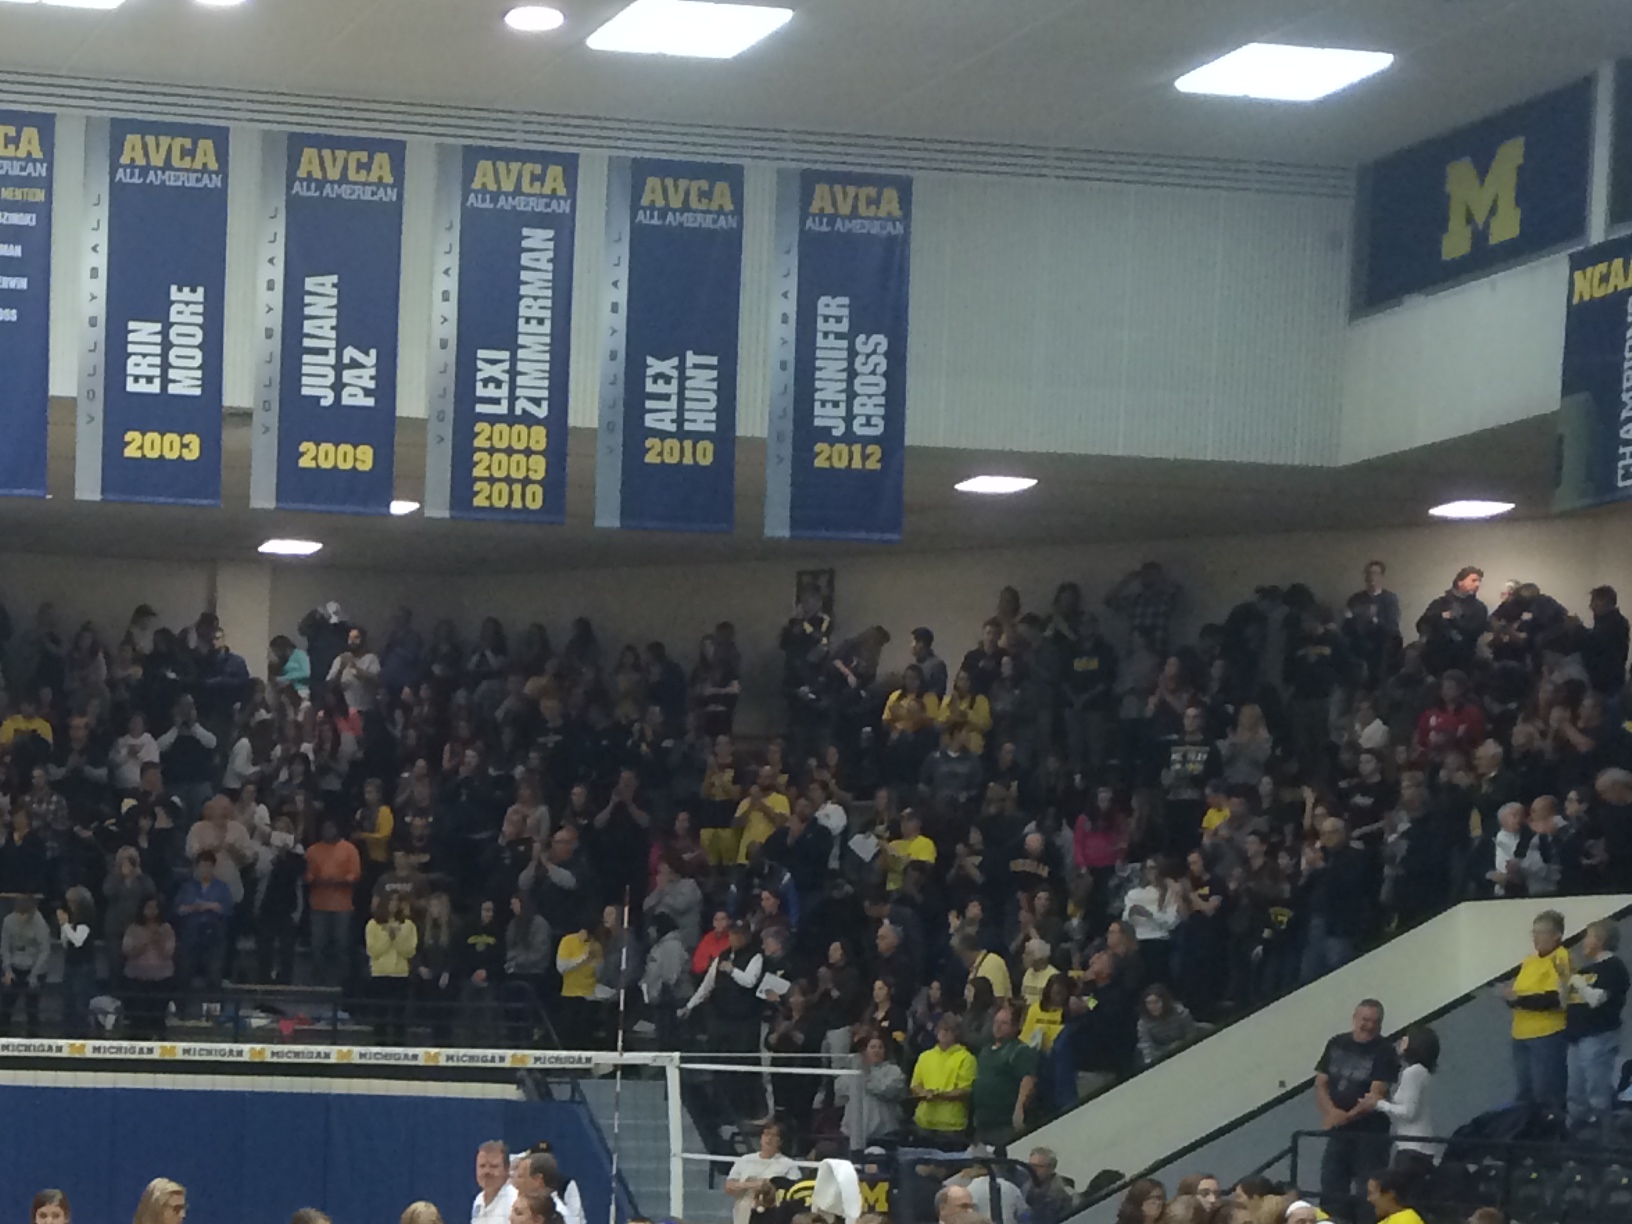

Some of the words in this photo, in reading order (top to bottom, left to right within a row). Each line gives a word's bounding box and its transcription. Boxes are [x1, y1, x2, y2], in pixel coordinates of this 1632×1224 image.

[120, 134, 218, 170] AVCA
[297, 147, 393, 184] AVCA
[115, 168, 143, 184] ALL
[147, 171, 222, 189] AMERICAN
[292, 180, 319, 197] ALL
[323, 184, 397, 202] AMERICAN
[471, 159, 566, 196] AVCA
[640, 176, 733, 212] AVCA
[467, 193, 494, 209] ALL
[497, 195, 570, 214] AMERICAN
[809, 183, 902, 218] AVCA
[1442, 136, 1525, 261] M
[635, 209, 663, 226] ALL
[666, 211, 737, 230] AMERICAN
[805, 217, 831, 232] ALL
[834, 218, 904, 235] AMERICAN
[85, 193, 101, 425] VOLLEYBALL
[515, 226, 555, 419] ZIMMERMAN
[126, 320, 162, 394] ERIN
[168, 284, 205, 396] MOORE
[301, 274, 338, 407] JULIANA
[342, 346, 377, 407] PAZ
[475, 348, 511, 416] LEXI
[814, 294, 850, 437] JENNIFER
[644, 354, 679, 433] ALEX
[684, 350, 718, 433] HUNT
[853, 333, 888, 437] CROSS
[123, 431, 200, 460] 2003
[473, 422, 547, 451] 2008
[644, 437, 714, 466] 2010
[298, 442, 373, 471] 2009
[472, 451, 546, 480] 2009
[814, 442, 881, 470] 2012
[472, 481, 543, 510] 2010
[0, 1043, 64, 1054] MICHIGAN
[91, 1046, 155, 1056] MICHIGAN
[181, 1048, 244, 1058] MICHIGAN
[270, 1050, 332, 1061] MICHIGAN
[358, 1051, 420, 1062] MICHIGAN
[445, 1054, 506, 1065] MICHIGAN
[533, 1056, 595, 1065] MICHIGAN
